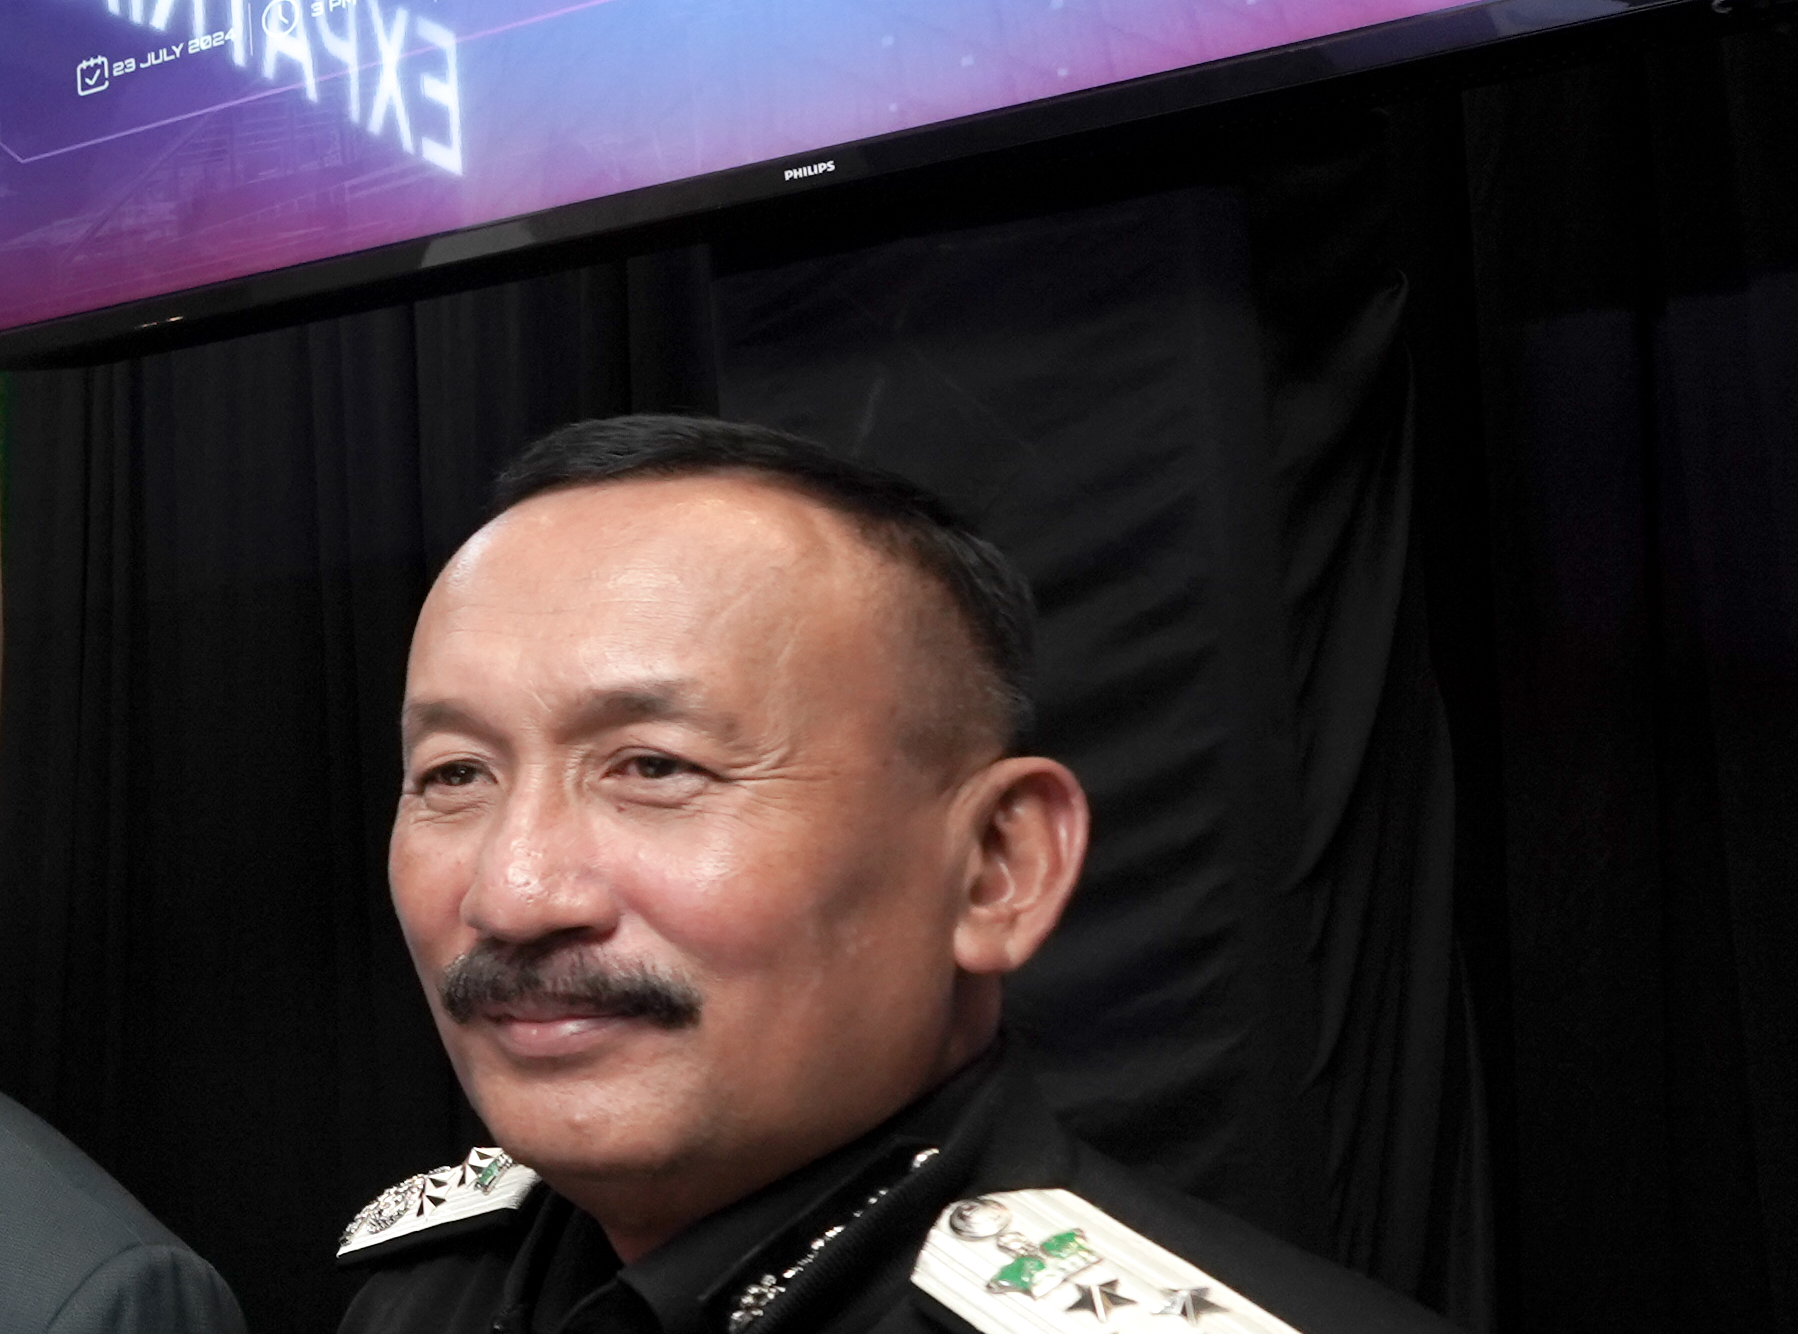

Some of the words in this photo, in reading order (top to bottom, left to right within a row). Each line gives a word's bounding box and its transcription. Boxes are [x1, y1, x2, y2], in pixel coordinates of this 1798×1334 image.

[310, 0, 324, 18] 3
[112, 57, 137, 78] 23
[139, 44, 185, 70] JULY
[188, 27, 237, 55] 2024
[783, 160, 836, 181] PHILIPS
